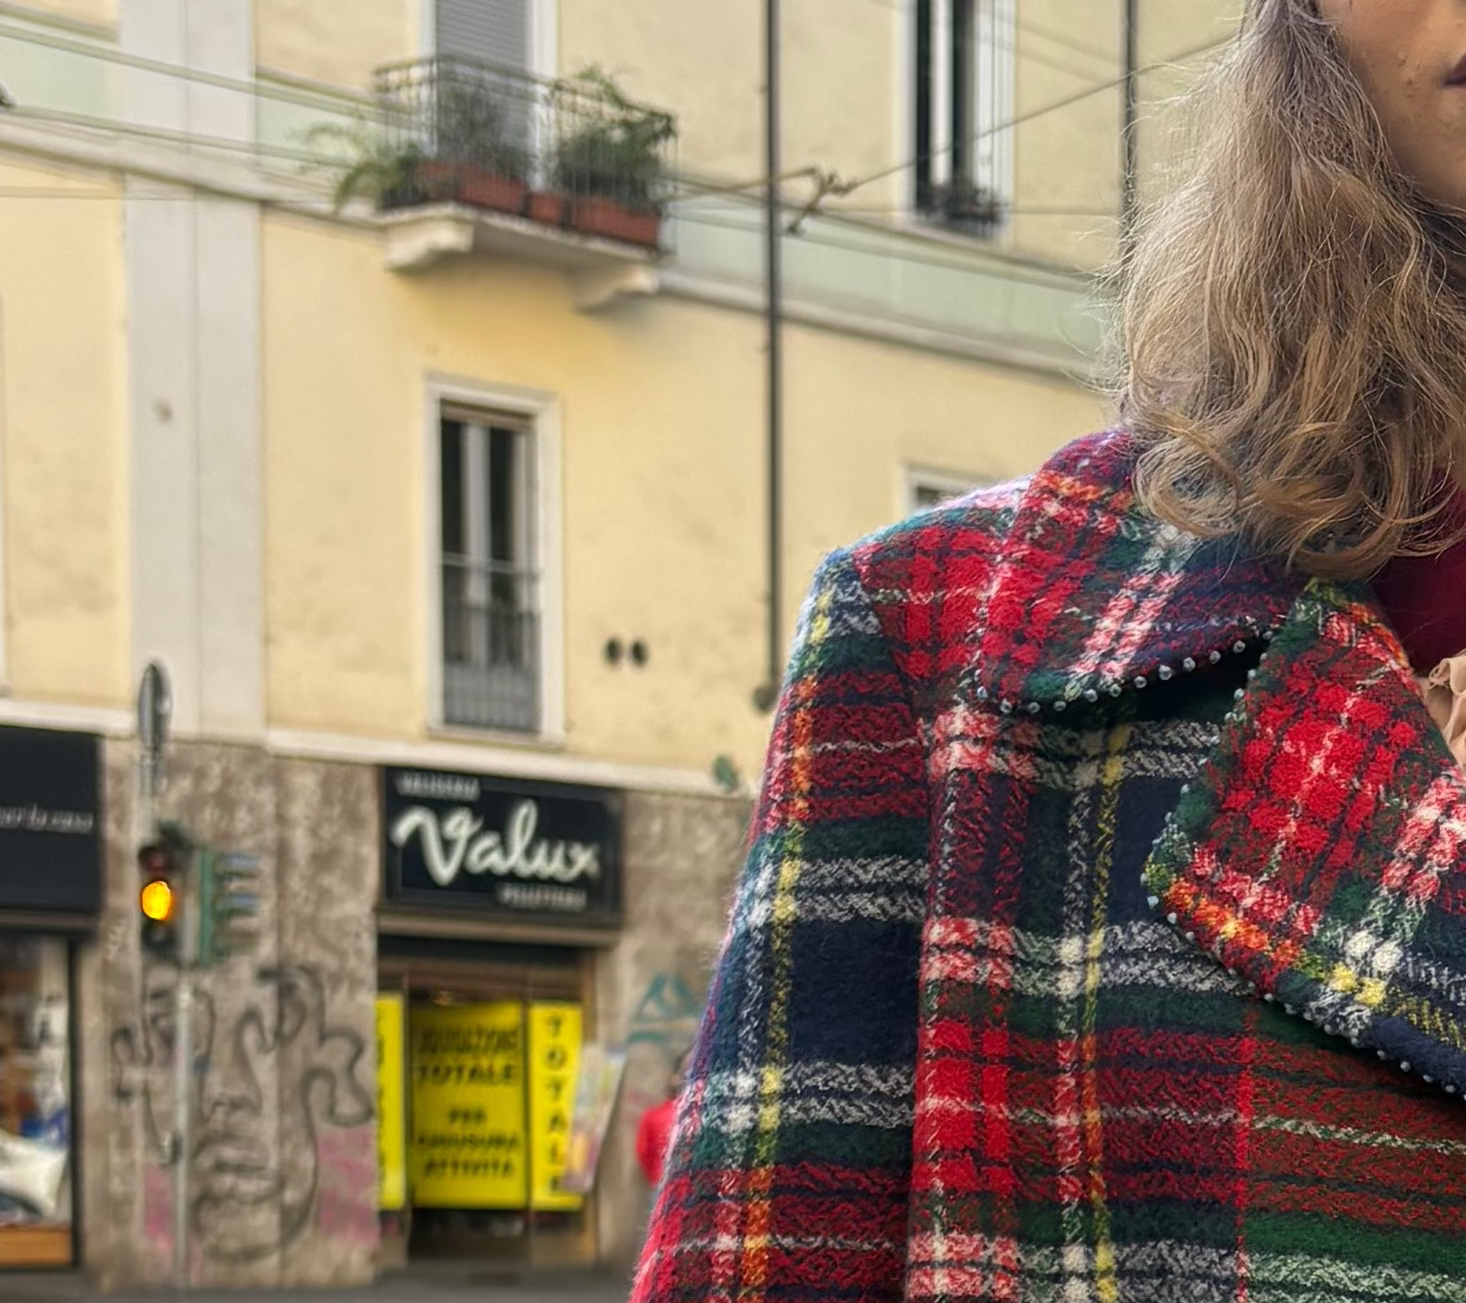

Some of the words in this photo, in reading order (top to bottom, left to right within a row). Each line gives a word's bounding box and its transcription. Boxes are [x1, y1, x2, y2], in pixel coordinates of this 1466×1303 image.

[390, 798, 600, 887] Valux
[417, 1062, 515, 1085] TOTALE
[448, 1107, 487, 1126] PER
